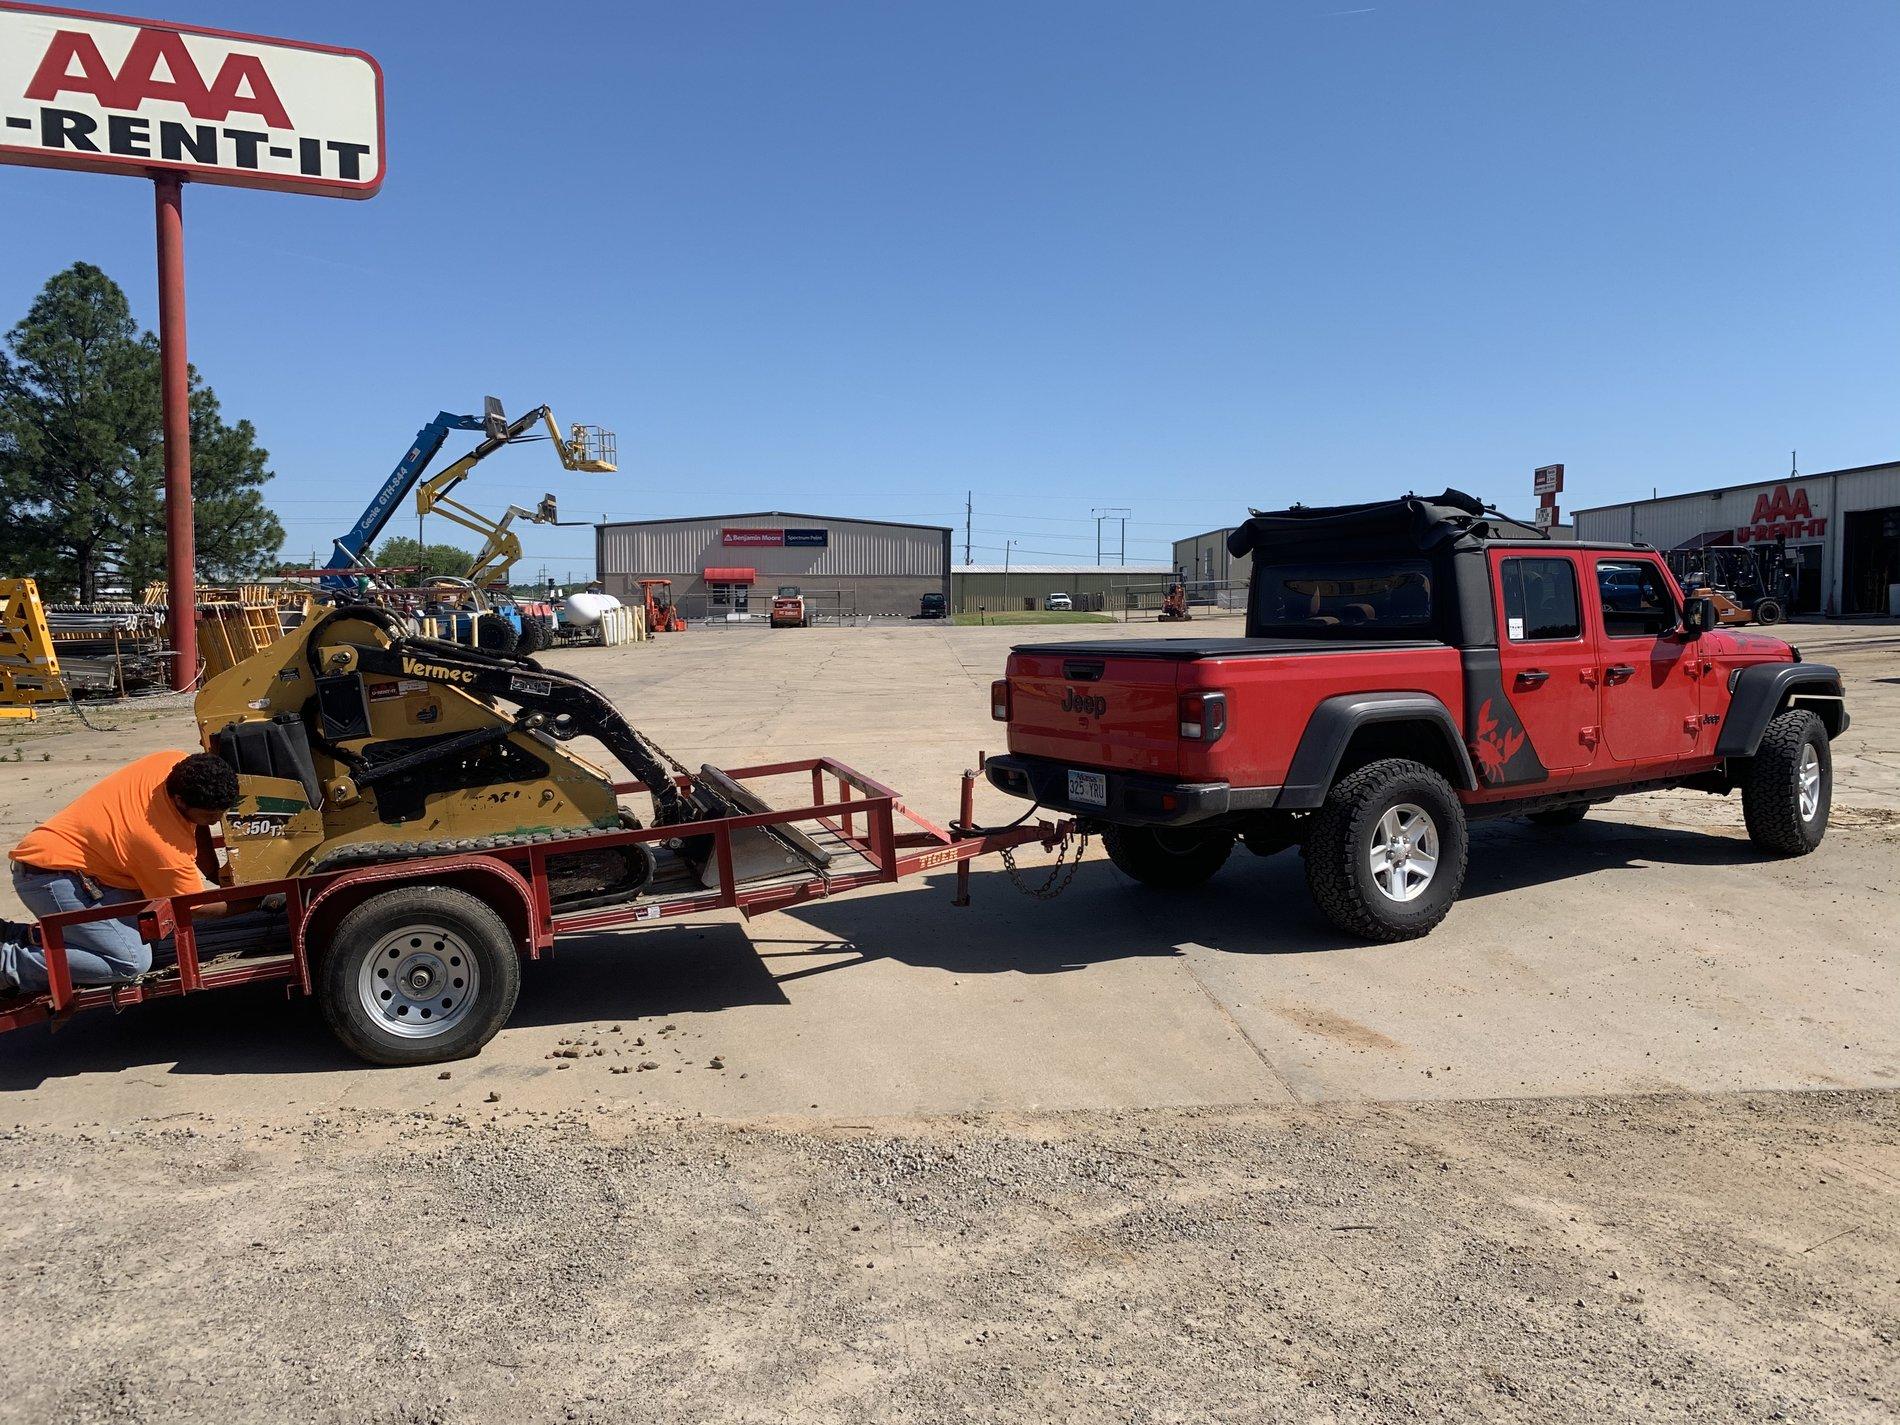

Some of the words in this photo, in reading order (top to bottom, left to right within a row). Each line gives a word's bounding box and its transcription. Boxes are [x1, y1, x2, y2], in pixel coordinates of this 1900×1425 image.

[24, 28, 295, 130] AAA
[361, 506, 381, 529] Genie
[379, 466, 408, 505] GTH-844
[1751, 485, 1812, 524] AAA
[732, 534, 761, 543] Benjamin
[1737, 518, 1828, 543] U-RENT-IT
[402, 656, 477, 683] Vermee
[1062, 686, 1106, 719] Jeep
[1069, 779, 1085, 795] 325
